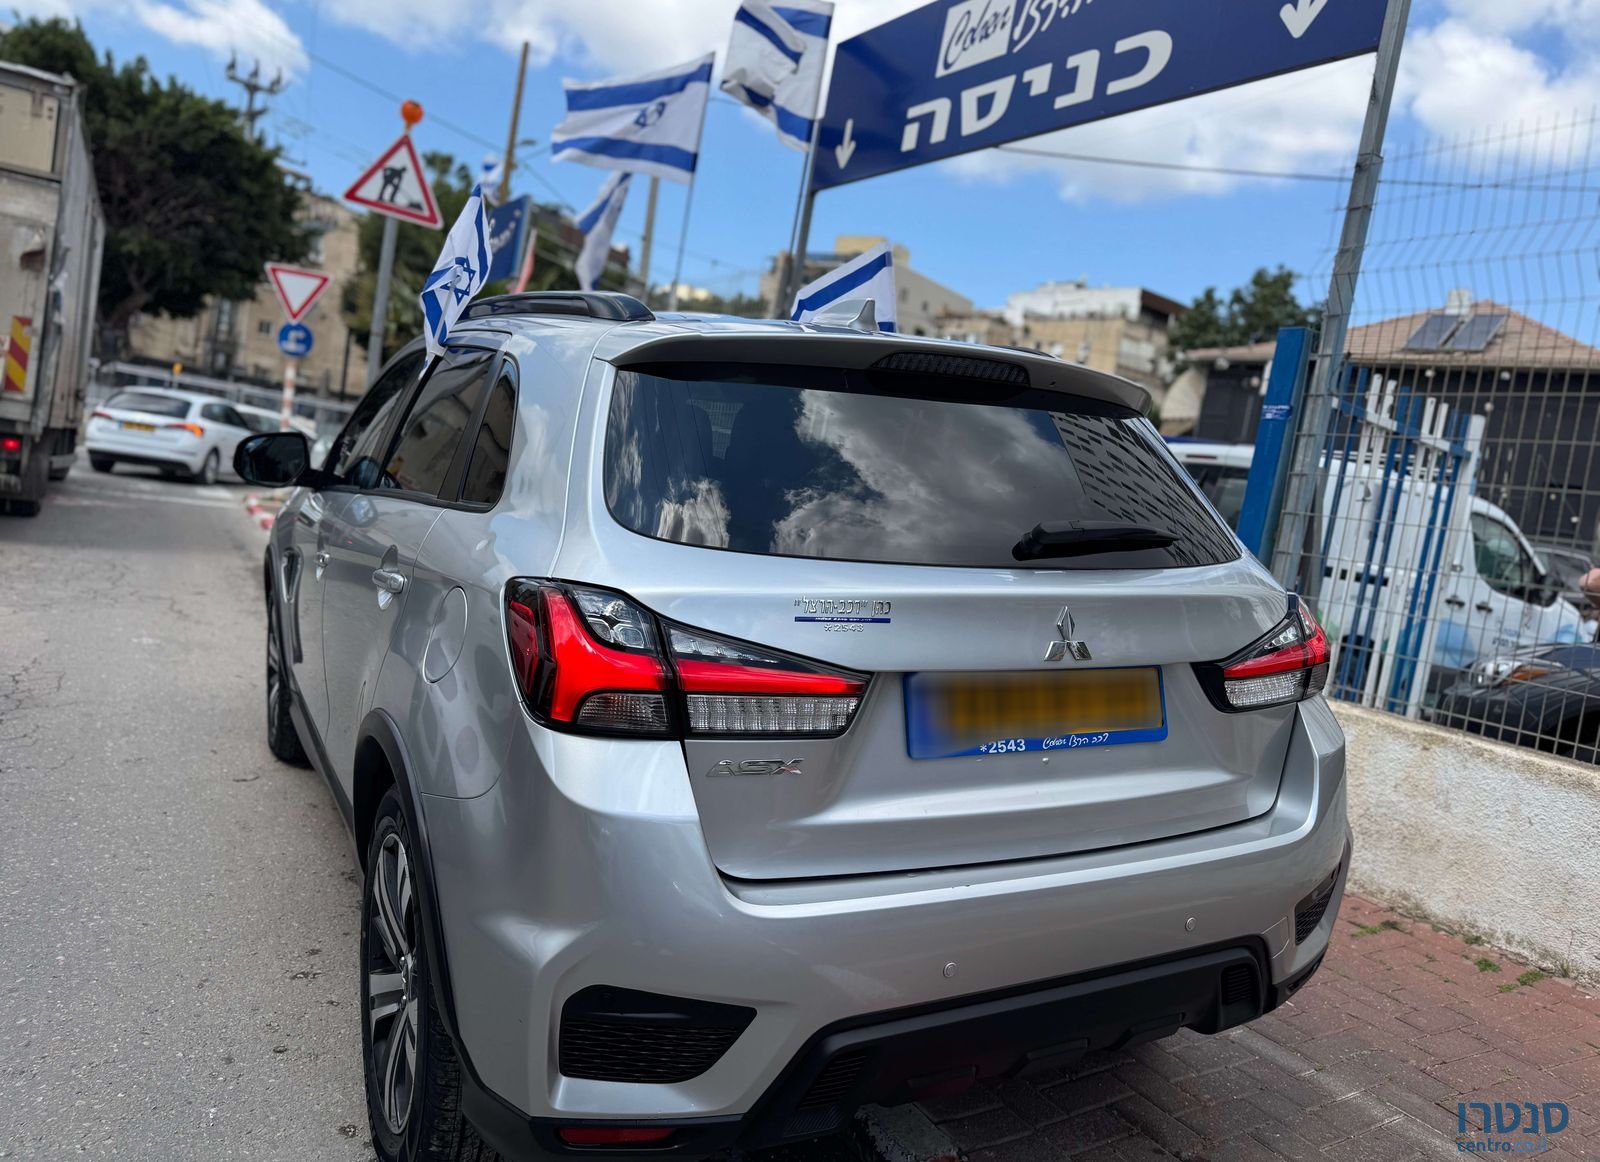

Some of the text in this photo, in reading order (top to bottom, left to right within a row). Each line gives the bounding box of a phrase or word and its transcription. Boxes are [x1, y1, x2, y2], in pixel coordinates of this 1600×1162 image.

[900, 29, 1174, 153] כניסה
[871, 600, 892, 617] כהן
[1091, 732, 1109, 743] רכב
[706, 758, 804, 777] ASX
